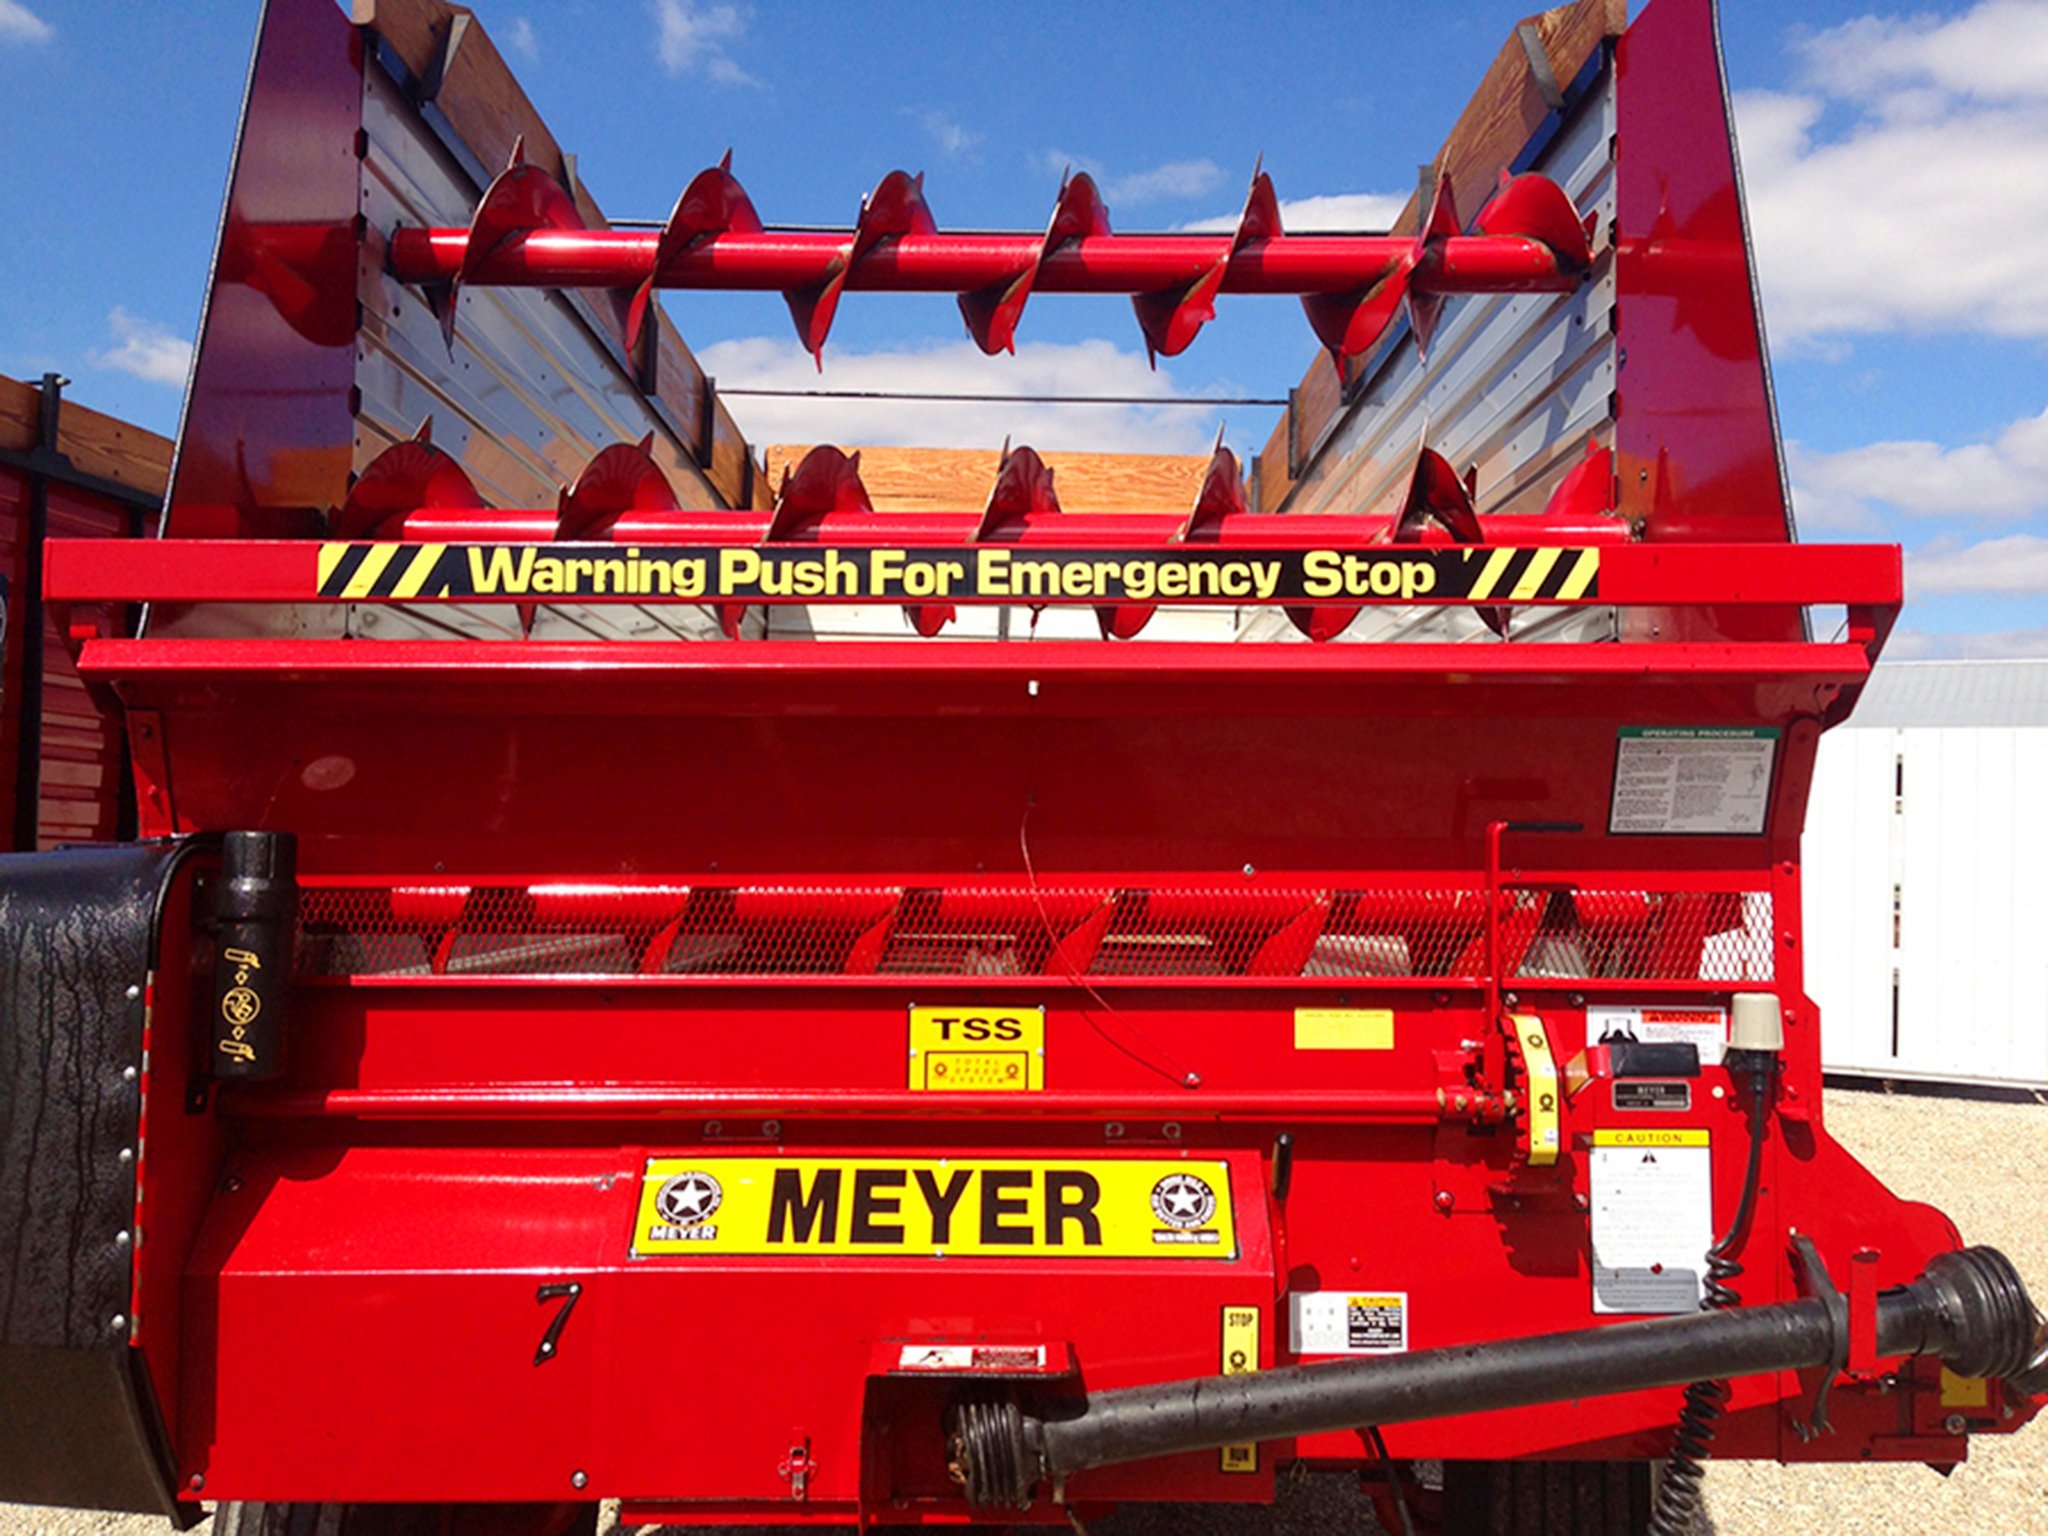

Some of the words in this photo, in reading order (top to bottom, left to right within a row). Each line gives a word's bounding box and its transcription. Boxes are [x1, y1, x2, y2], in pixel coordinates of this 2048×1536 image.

[466, 547, 706, 597] Warning
[719, 549, 865, 596] Push
[870, 549, 964, 596] For
[977, 549, 1281, 598] Emergency
[1301, 549, 1437, 598] Stop
[931, 1018, 1022, 1040] TSS
[1615, 1133, 1683, 1143] CAUTION
[766, 1168, 1102, 1246] MEYER
[649, 1226, 717, 1240] MEYER
[533, 1281, 583, 1367] 7
[1229, 1312, 1253, 1328] STOP
